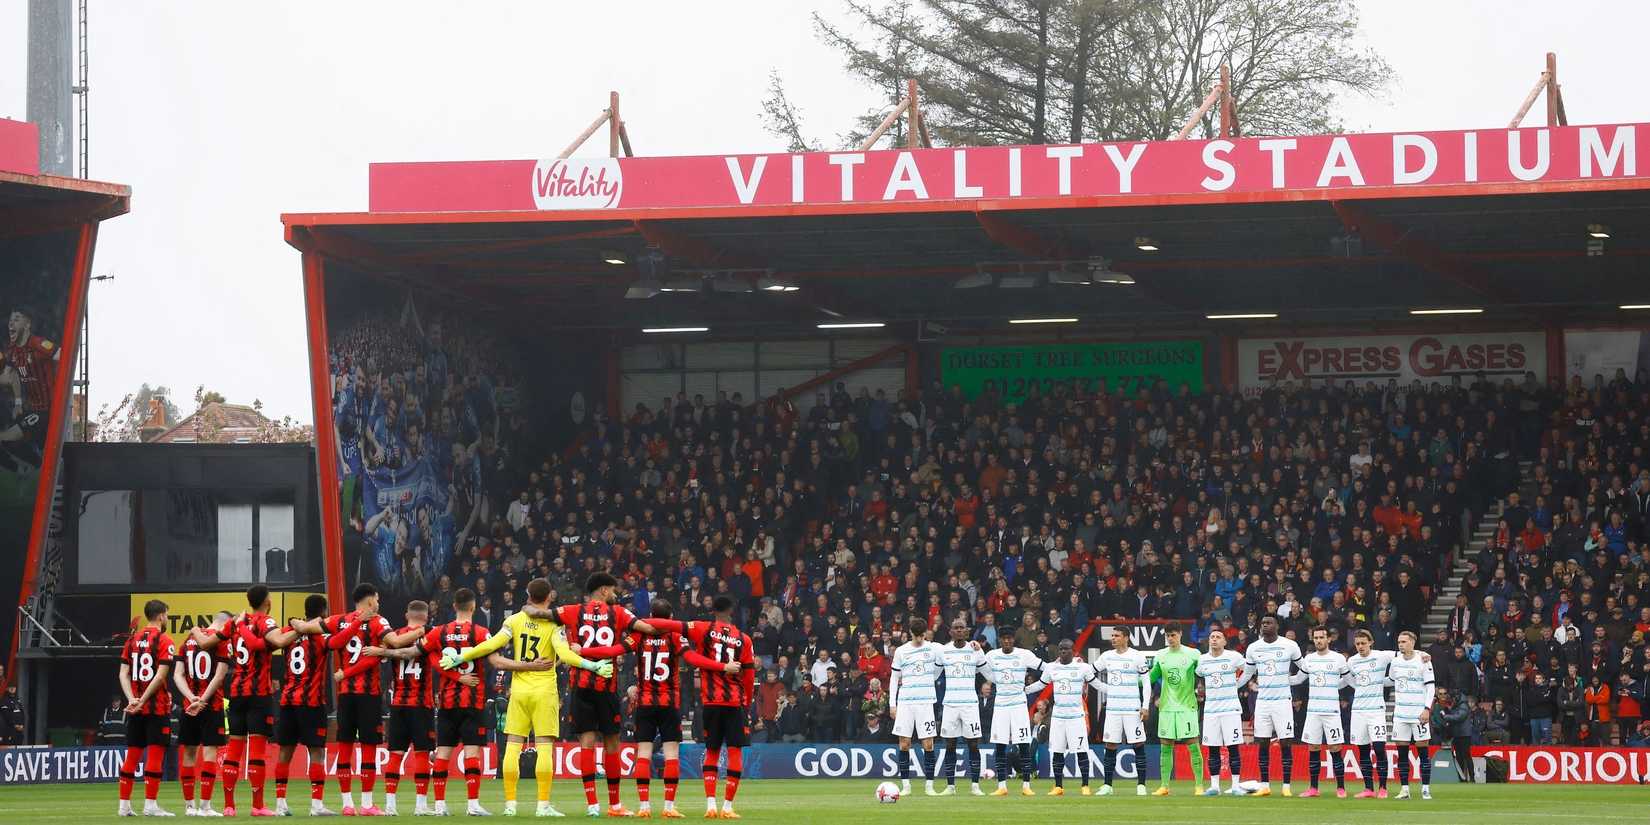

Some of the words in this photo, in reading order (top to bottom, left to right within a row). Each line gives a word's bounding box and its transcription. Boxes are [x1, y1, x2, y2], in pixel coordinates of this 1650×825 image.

[725, 143, 1148, 204] VITALITY
[1200, 125, 1637, 191] STADIUM
[537, 159, 618, 208] Vitality
[949, 351, 1024, 369] DORSET
[1033, 350, 1083, 369] TREE
[1091, 346, 1197, 367] SURGEONS
[1257, 342, 1402, 379] EXPRESS
[1409, 337, 1526, 376] GASES
[520, 633, 540, 662] 13
[578, 625, 614, 648] 29
[290, 646, 305, 675] 8
[346, 636, 362, 664] 9
[131, 652, 154, 682] 18
[186, 650, 212, 680] 10
[399, 656, 422, 680] 14
[643, 651, 670, 682] 15
[1167, 667, 1181, 686] 3
[970, 722, 980, 733] 14
[1019, 727, 1028, 738] 31
[1135, 726, 1142, 736] 6
[1186, 722, 1191, 732] 1
[1232, 728, 1239, 739] 5
[1286, 722, 1292, 731] 4
[1329, 728, 1341, 739] 21
[1374, 725, 1386, 736] 23
[1417, 724, 1428, 735] 15
[1078, 736, 1084, 747] 7
[4, 751, 50, 782] SAVE
[53, 750, 90, 779] THE
[795, 747, 873, 777] GOD
